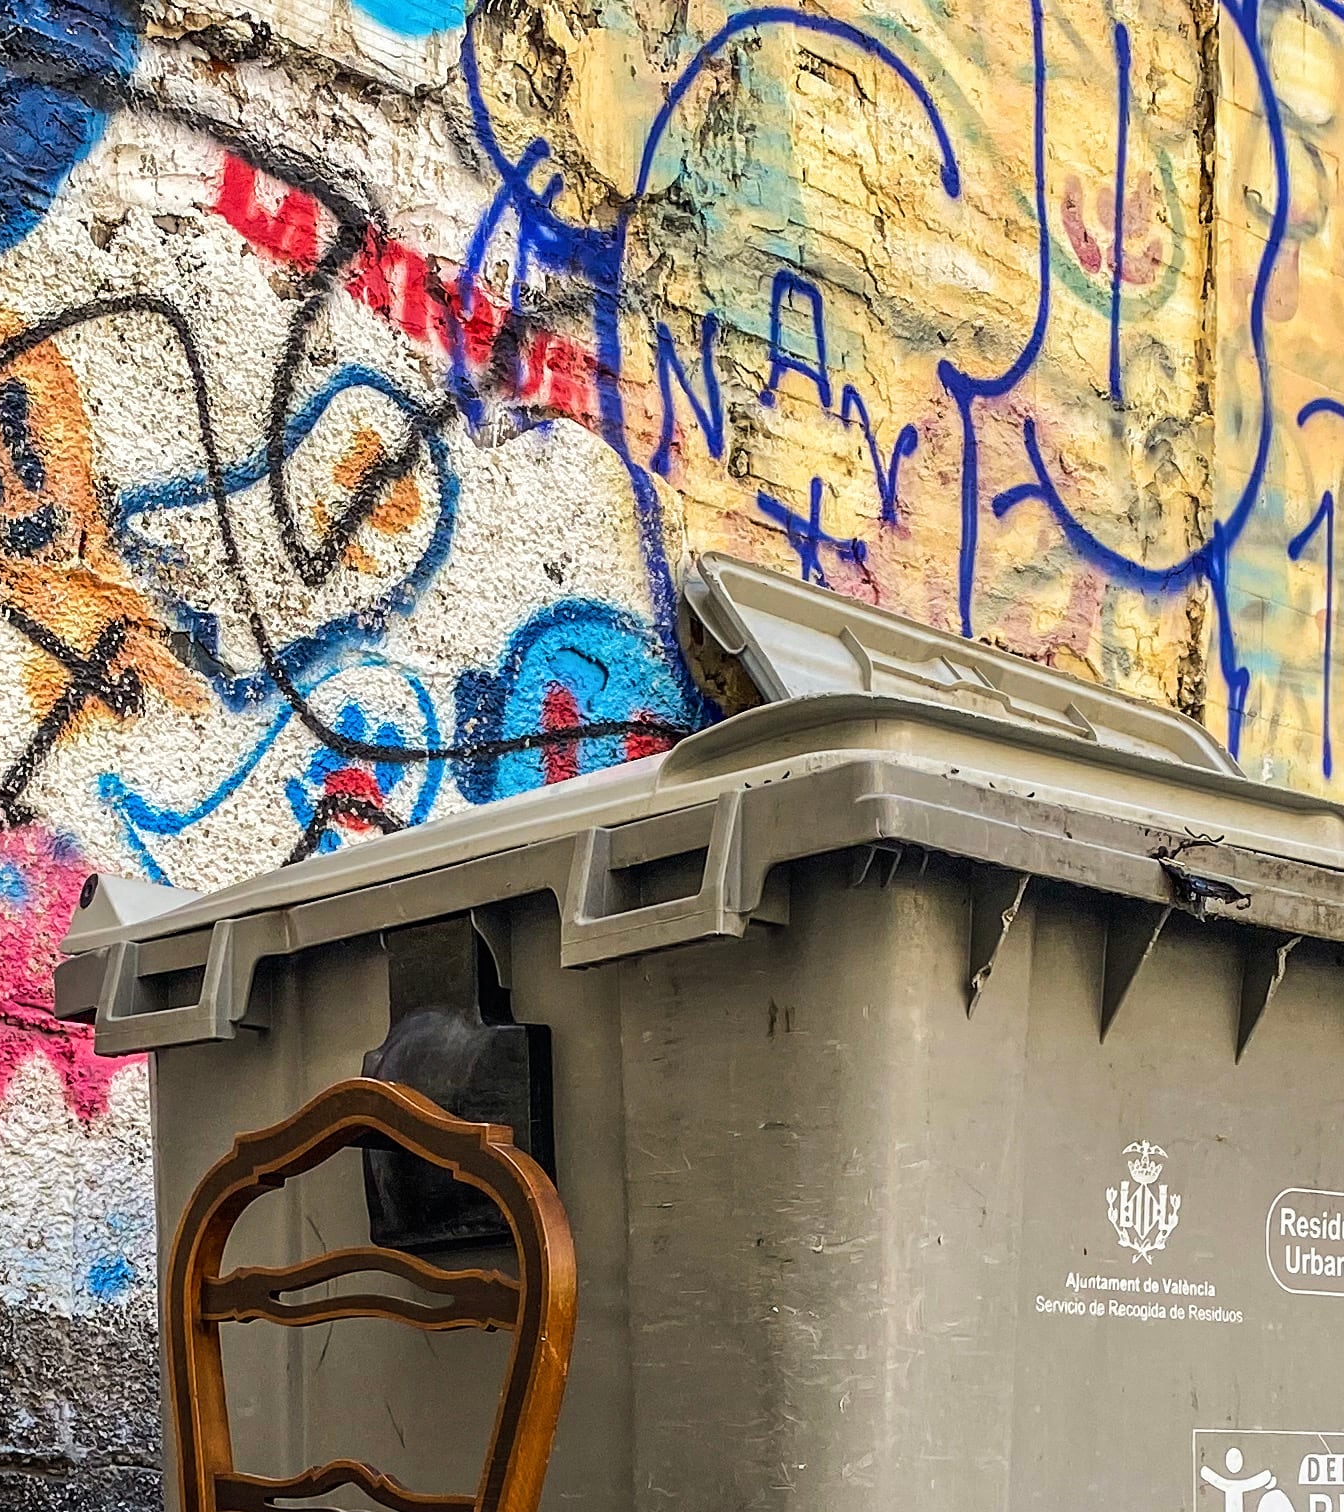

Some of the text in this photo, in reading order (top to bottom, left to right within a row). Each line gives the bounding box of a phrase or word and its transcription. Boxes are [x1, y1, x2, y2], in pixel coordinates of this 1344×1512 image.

[1066, 1272, 1216, 1297] Ajuntament de València
[1036, 1295, 1243, 1323] Servicio de Recogida de Residuos
